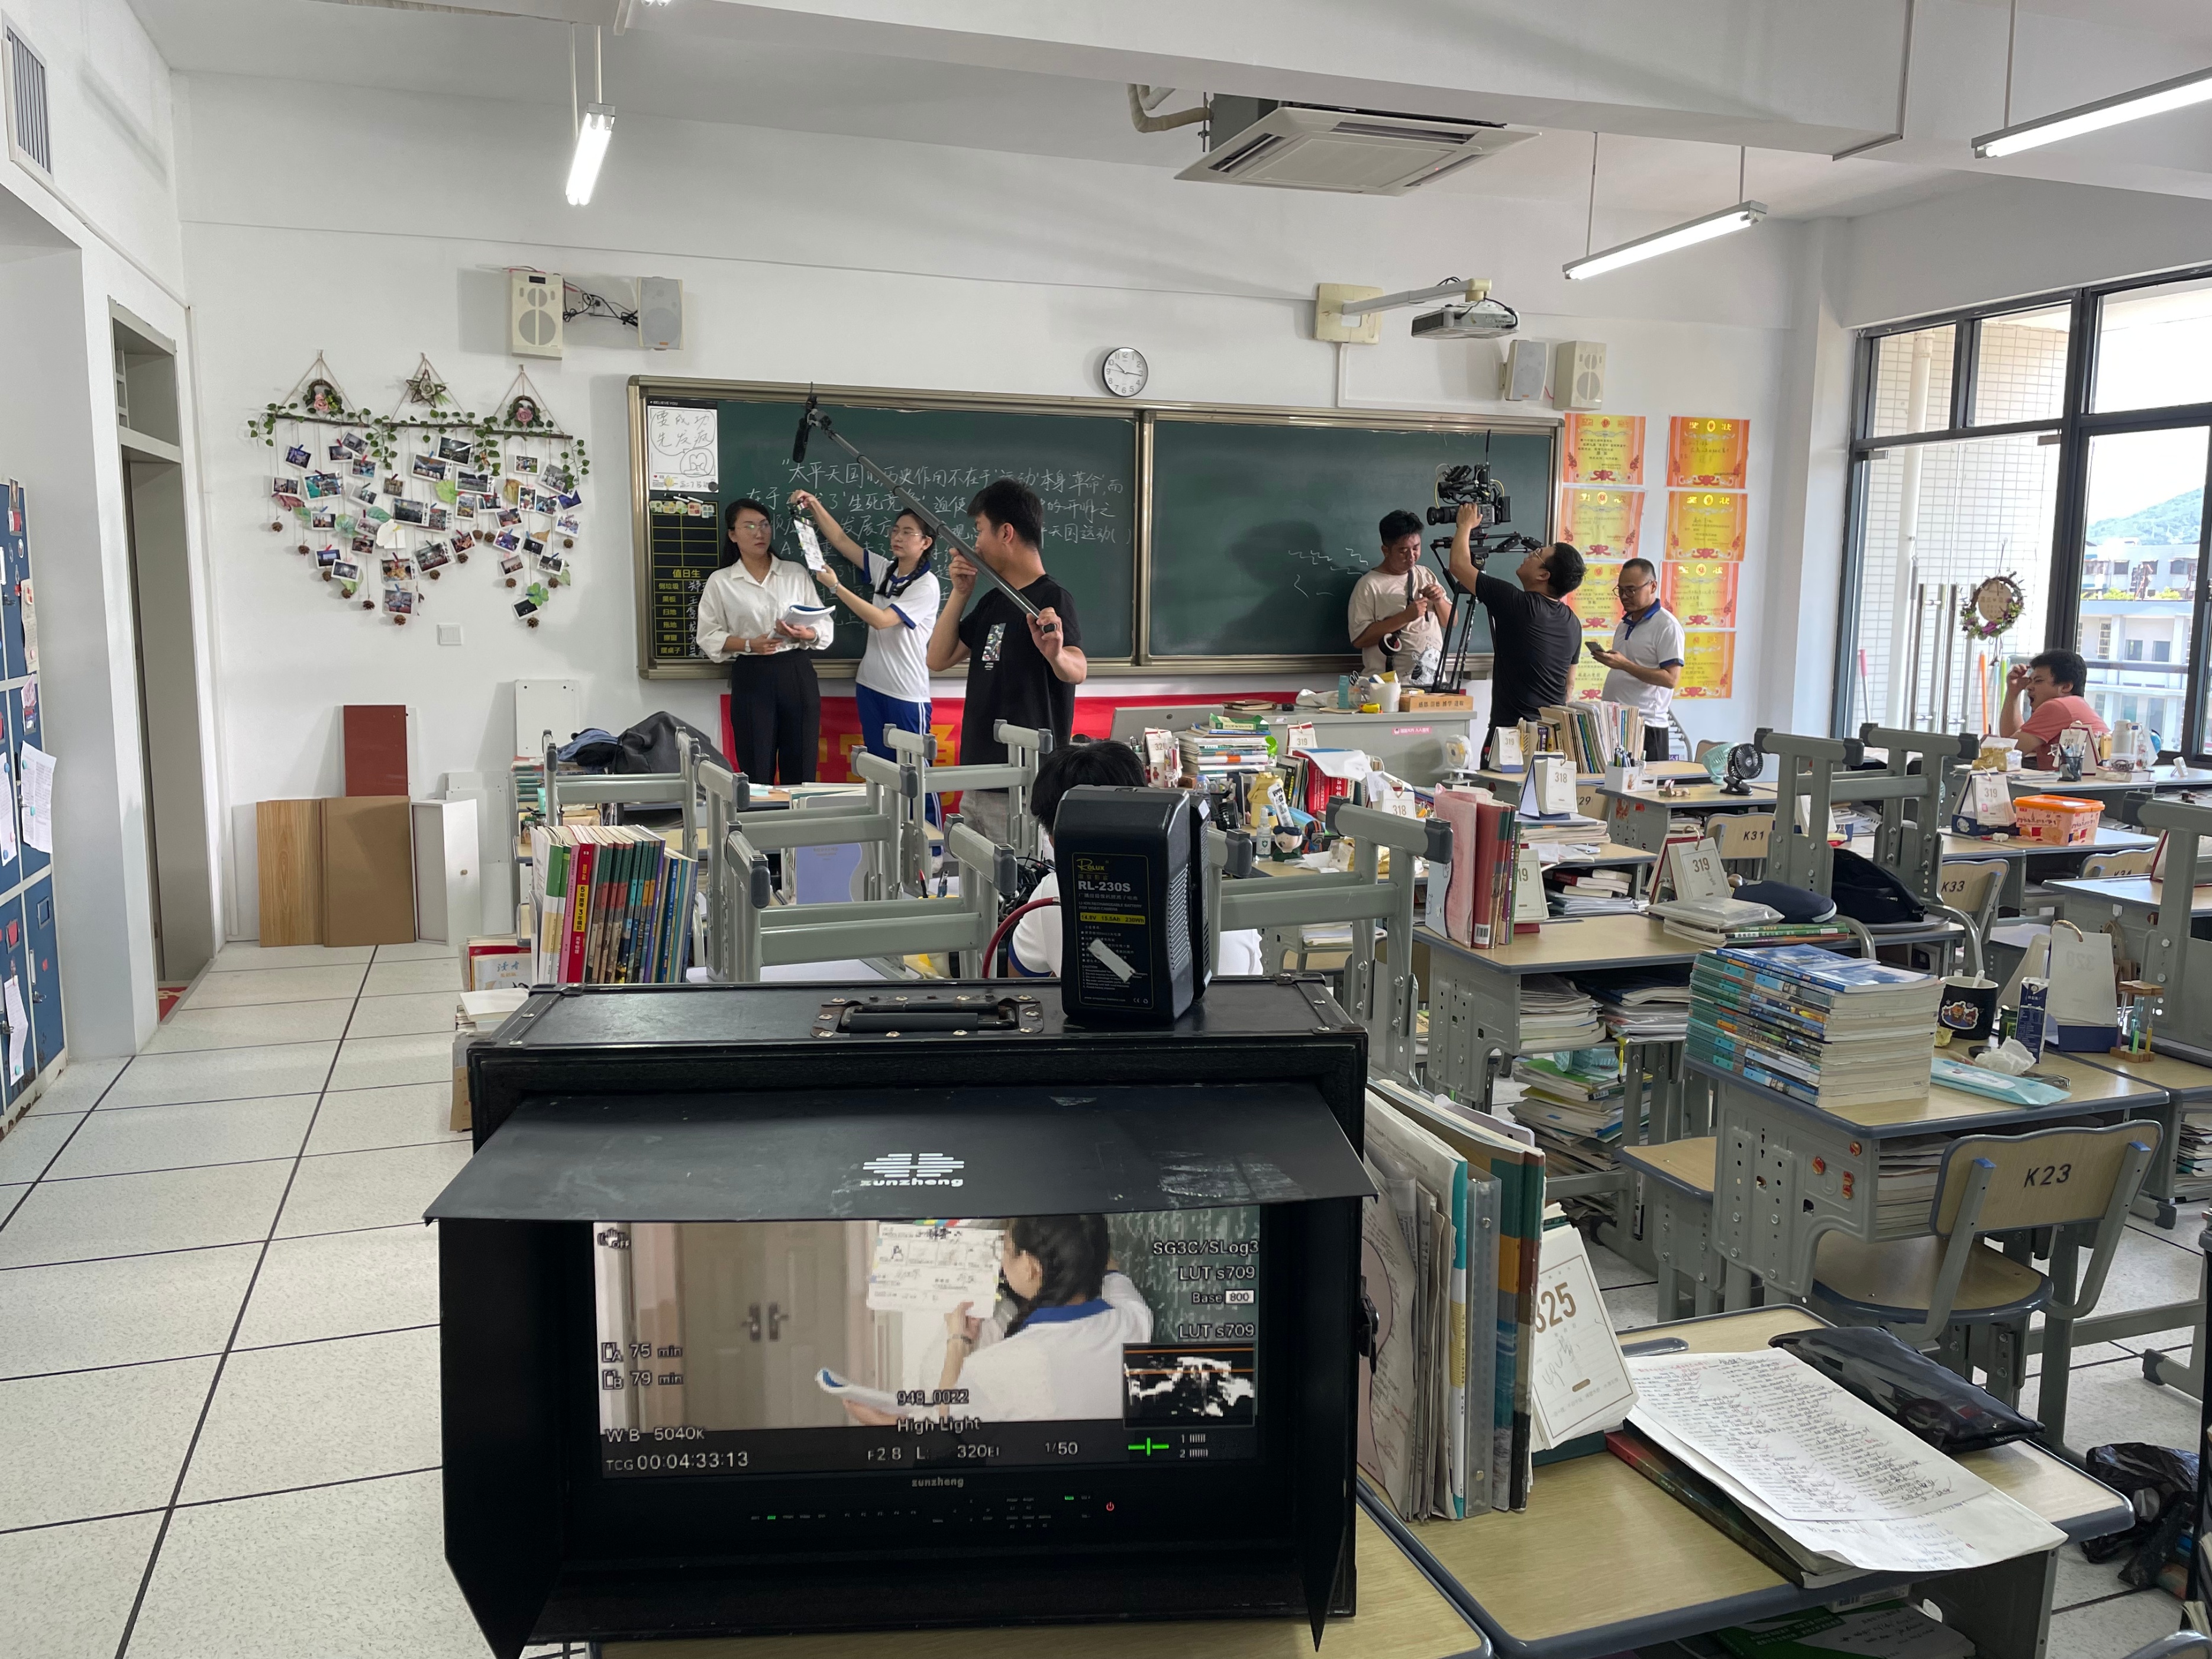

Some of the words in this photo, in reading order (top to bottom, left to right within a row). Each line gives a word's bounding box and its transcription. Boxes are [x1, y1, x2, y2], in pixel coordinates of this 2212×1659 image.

[656, 411, 709, 430] 要成功
[673, 569, 701, 579] 值日生
[1554, 772, 1568, 783] 318
[1984, 787, 1998, 798] 319
[1577, 796, 1591, 806] 29
[1393, 805, 1407, 816] 318
[1743, 830, 1765, 841] K31
[1693, 857, 1710, 873] 319
[1078, 880, 1131, 892] RL-230S
[1941, 880, 1966, 893] K33
[2024, 1163, 2072, 1187] K23
[1152, 1240, 1260, 1255] SG3C/SLog3
[1178, 1266, 1211, 1281] LUT
[1215, 1265, 1255, 1280] s709
[1192, 1290, 1222, 1304] Base
[1229, 1291, 1249, 1302] 800
[1178, 1324, 1211, 1338] LUT
[1215, 1323, 1255, 1338] s709
[631, 1344, 651, 1358] 75
[657, 1346, 683, 1358] min
[632, 1371, 651, 1386] 79
[658, 1373, 684, 1385] min
[897, 1390, 969, 1406] 948_0022
[897, 1416, 935, 1435] High
[939, 1416, 981, 1434] Light
[654, 1426, 705, 1441] 5040K
[1044, 1441, 1078, 1456] 1/50
[606, 1460, 634, 1471] TCG
[637, 1451, 748, 1470] 00:04:33:13
